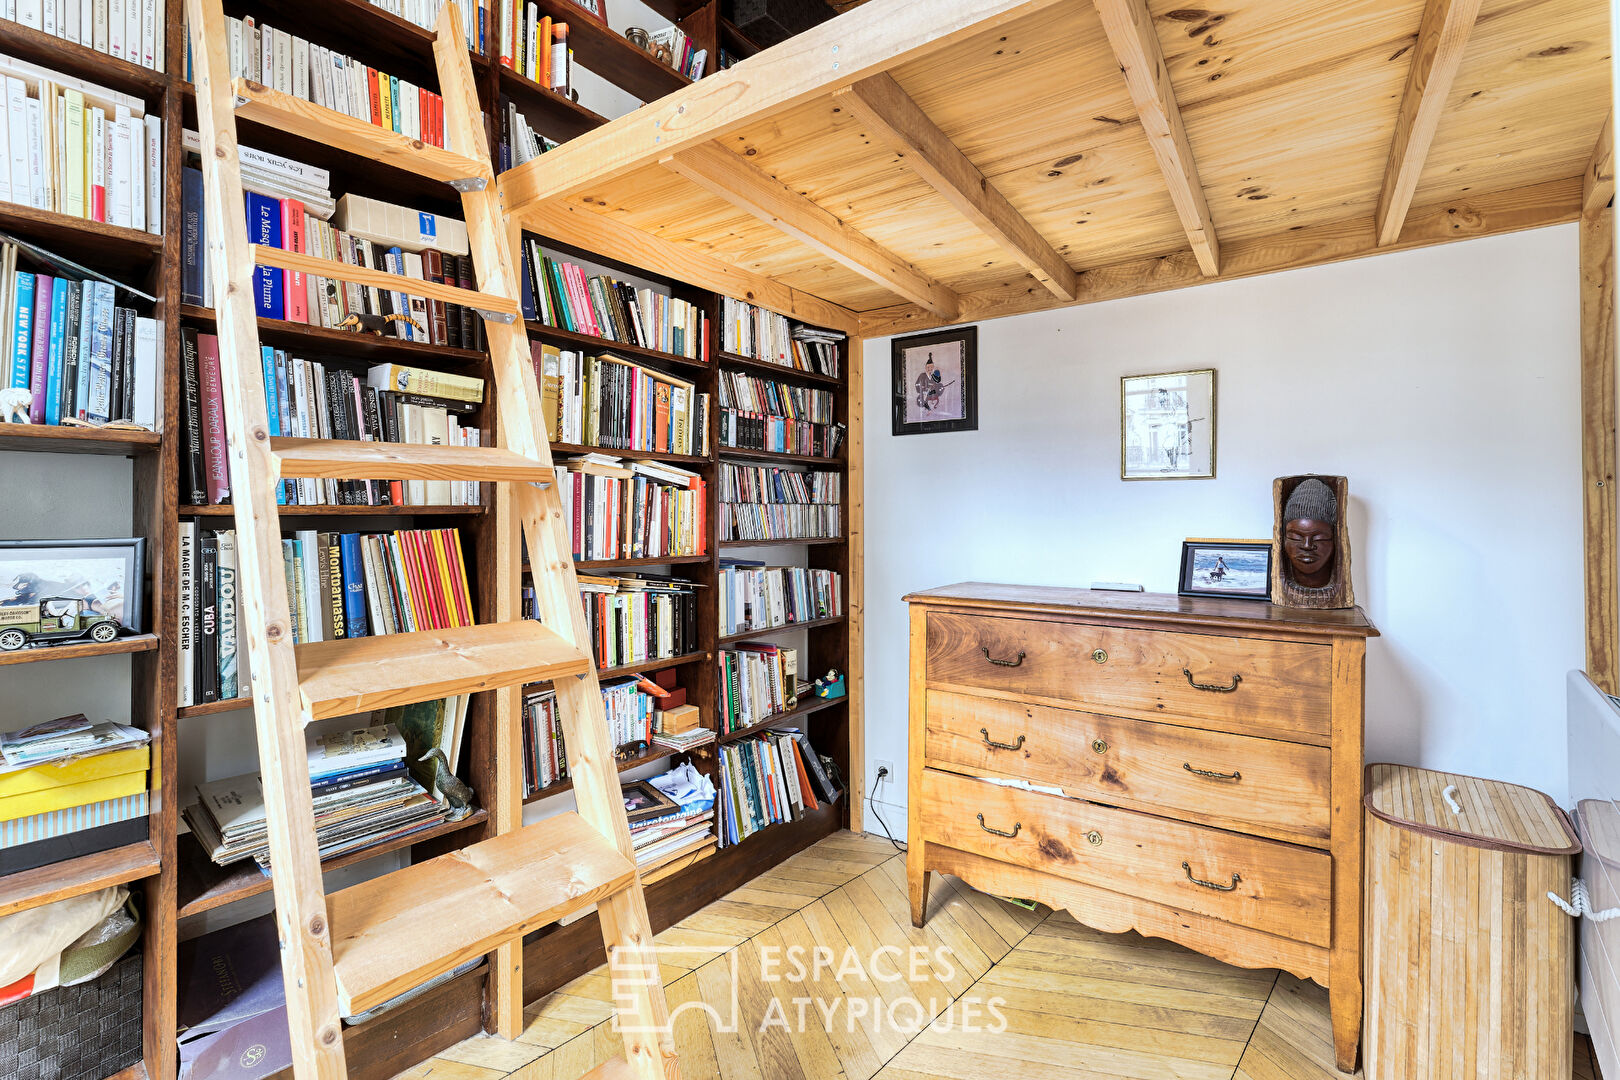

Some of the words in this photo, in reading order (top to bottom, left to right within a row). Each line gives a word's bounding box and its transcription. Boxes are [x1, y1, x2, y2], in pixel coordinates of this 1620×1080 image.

[244, 151, 265, 164] noirs
[267, 158, 288, 172] yeux
[289, 164, 304, 177] Les
[261, 205, 271, 217] Le
[260, 218, 271, 247] Masqu
[263, 267, 273, 277] la
[263, 278, 273, 309] Plume
[19, 307, 29, 328] NEW
[17, 329, 28, 356] YORK
[15, 357, 27, 387] STYL
[185, 341, 197, 384] fantastique
[210, 356, 218, 393] DEMEURE
[265, 355, 275, 375] CASPAR
[268, 375, 276, 392] DAVID
[189, 405, 199, 428] Brion
[207, 397, 221, 434] DARAUX
[210, 436, 224, 481] JEAN-LOUP
[181, 536, 190, 546] LA
[181, 550, 190, 577] MAGIE
[319, 546, 328, 570] Lewis
[181, 580, 190, 592] DE
[329, 545, 344, 637] Montparnasse
[204, 605, 215, 635] CUBA
[221, 569, 236, 659] VAUDOU
[181, 616, 190, 651] ESCHER
